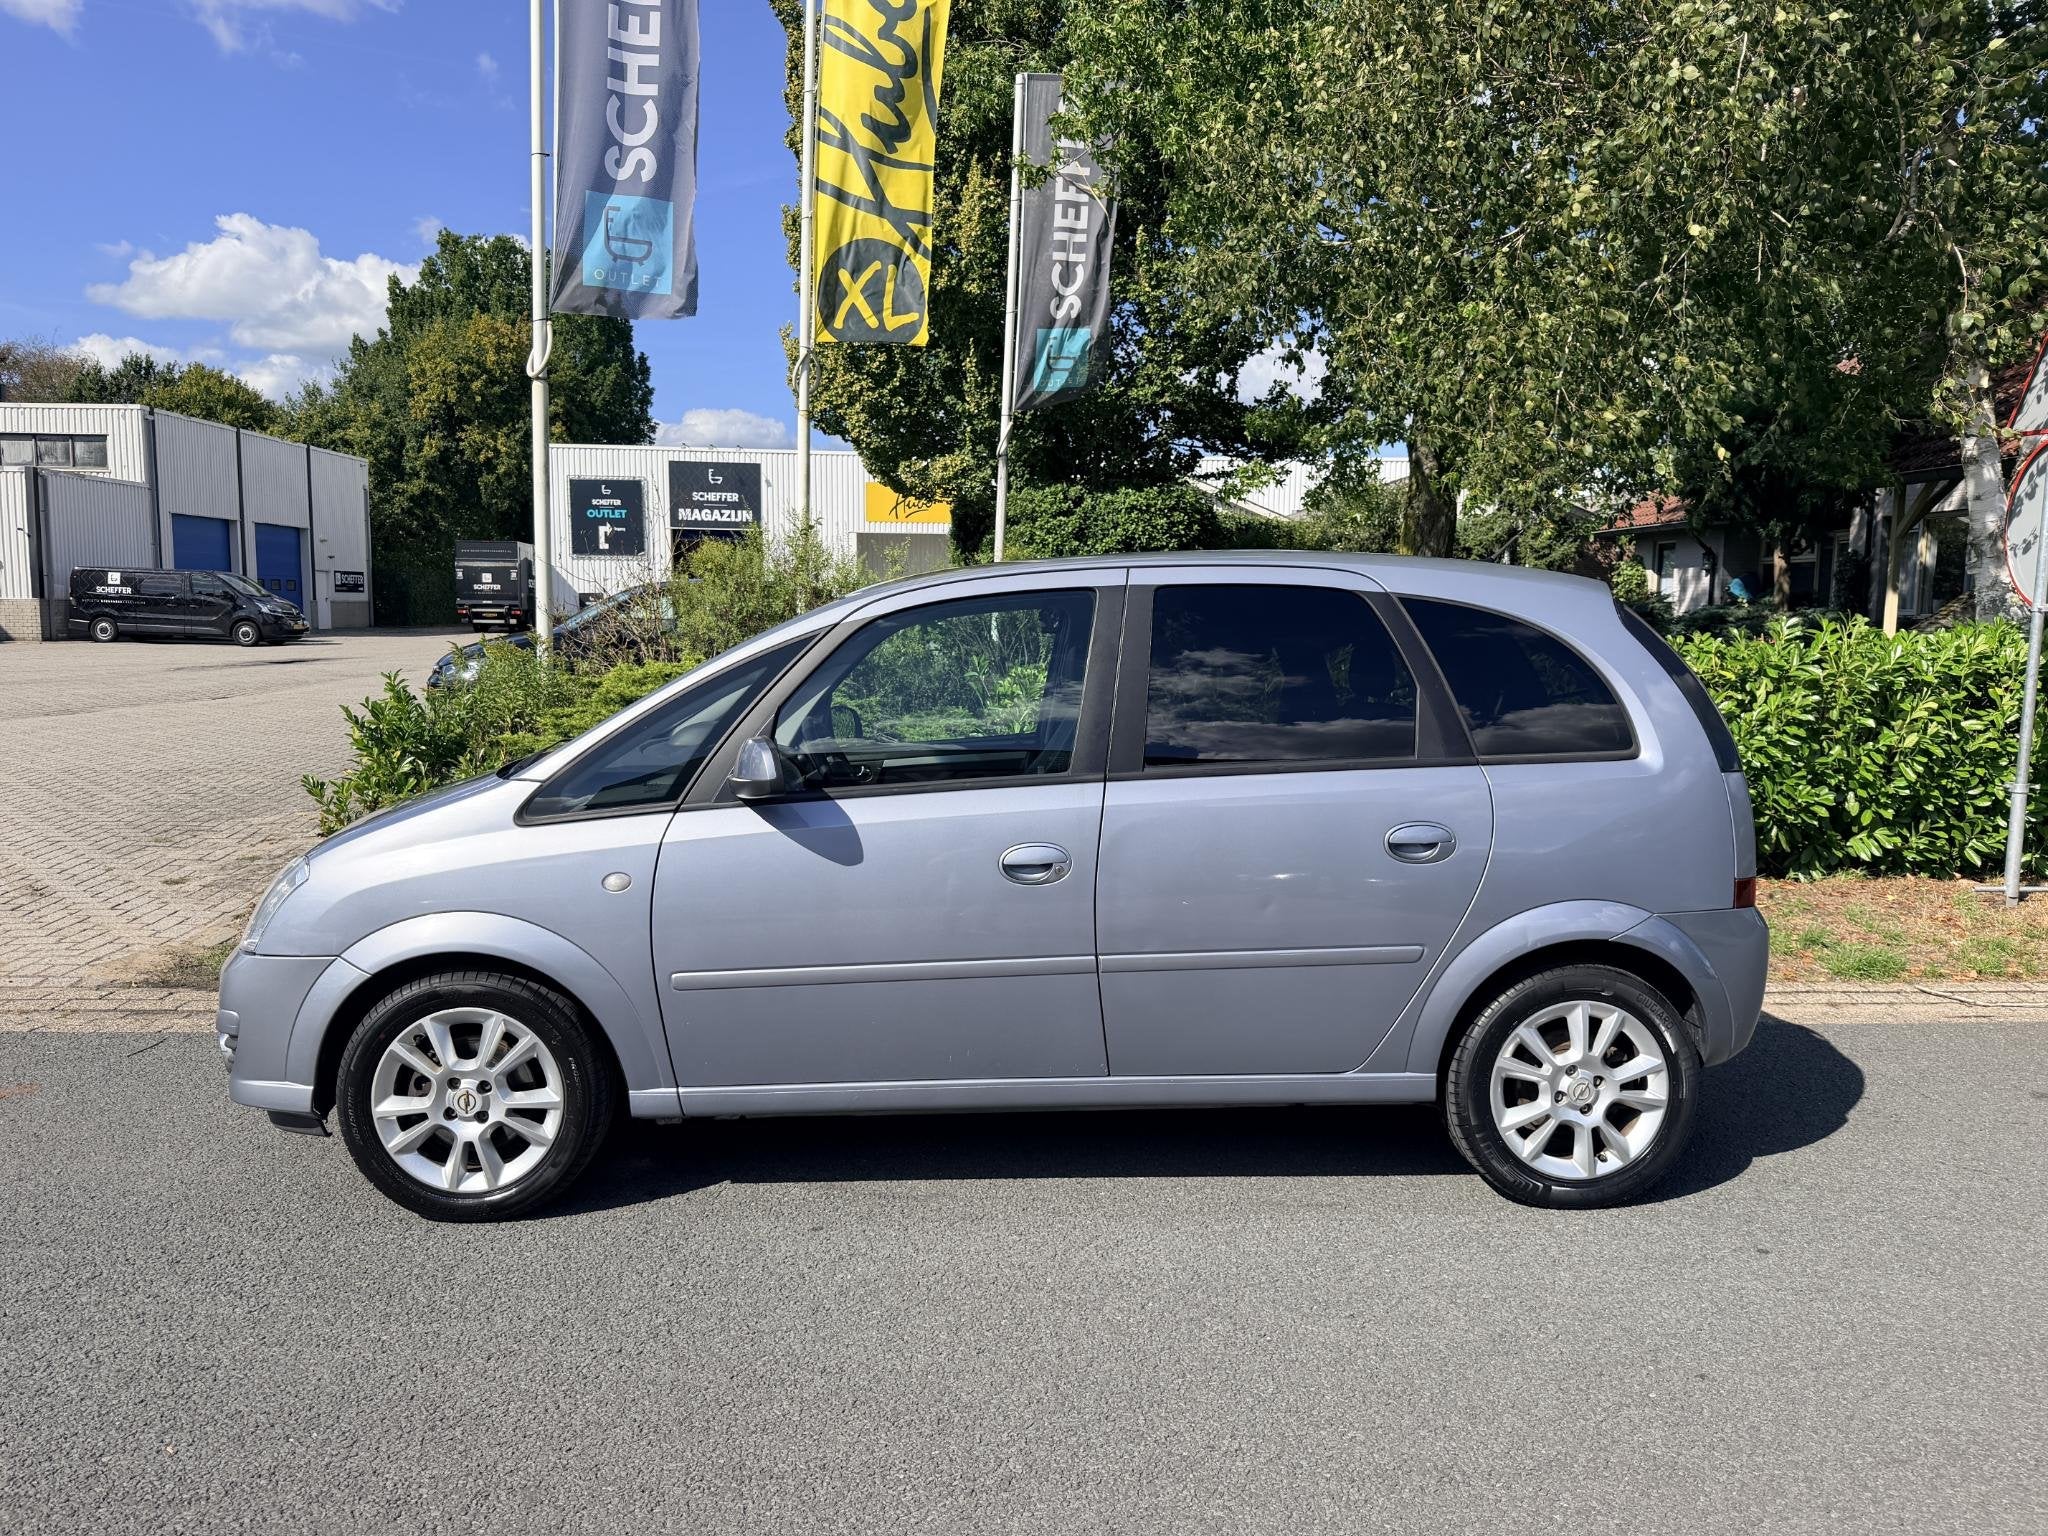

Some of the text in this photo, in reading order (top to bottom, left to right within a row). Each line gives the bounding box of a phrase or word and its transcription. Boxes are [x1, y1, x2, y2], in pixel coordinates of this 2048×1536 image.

[604, 0, 662, 182] SCHE
[1050, 93, 1091, 321] SCHEFF
[594, 268, 664, 289] OUTLET
[833, 260, 920, 332] XL
[1039, 376, 1081, 387] OUTET
[591, 498, 622, 506] SCHEFFER
[692, 491, 740, 502] SCHEFFER
[586, 509, 627, 518] OUTLET
[678, 507, 754, 522] MAGAZIJN
[96, 585, 132, 595] SCHEFFER
[473, 583, 501, 591] SCHEFFER
